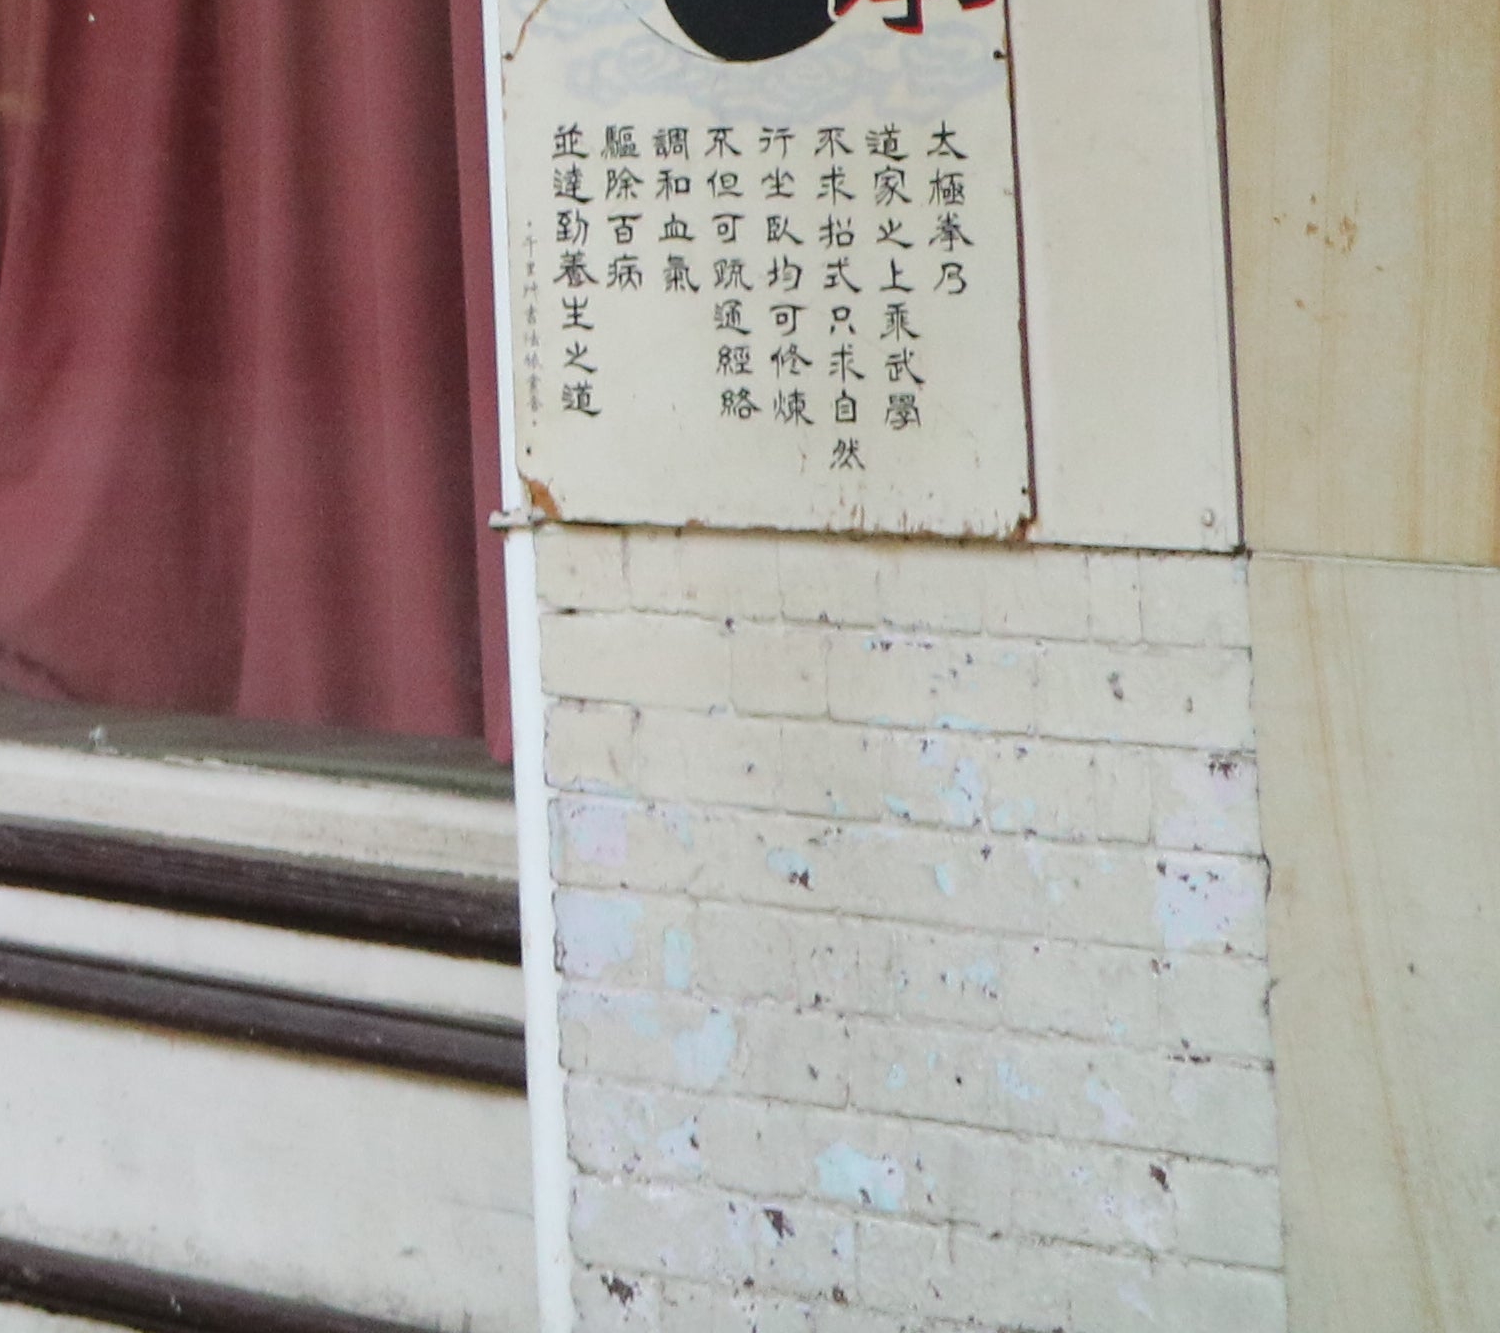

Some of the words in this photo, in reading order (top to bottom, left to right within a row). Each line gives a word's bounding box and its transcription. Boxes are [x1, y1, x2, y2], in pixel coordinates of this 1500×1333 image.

[600, 125, 644, 291] 驅除百病
[653, 127, 701, 295] 調和血氣
[704, 126, 762, 421] 不但可疏通經絡
[814, 126, 866, 471] 不求招式只求自然
[865, 127, 925, 431] 道家之上乘武學
[926, 120, 974, 295] 太極拳乃
